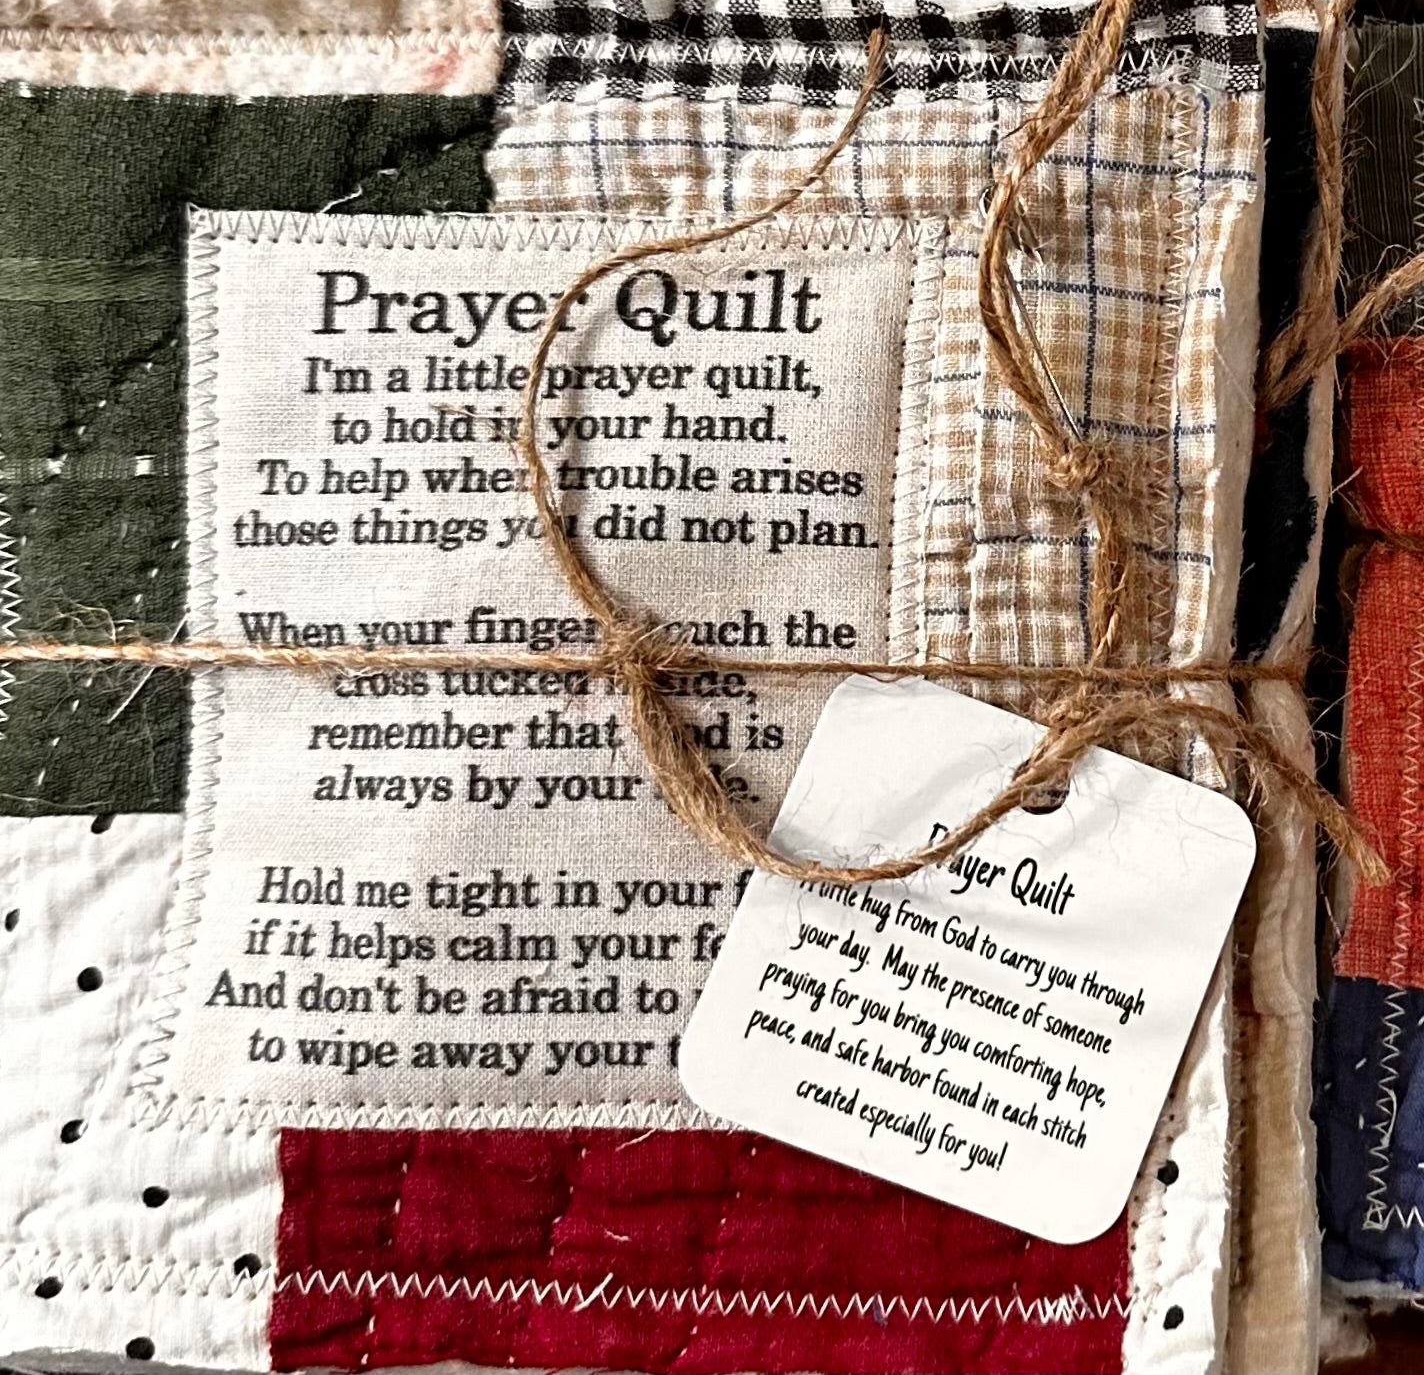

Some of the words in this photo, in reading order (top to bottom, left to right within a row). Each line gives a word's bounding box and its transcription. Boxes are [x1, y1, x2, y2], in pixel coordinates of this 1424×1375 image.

[311, 269, 592, 348] Prayer
[613, 268, 824, 348] Quilt
[301, 356, 373, 395] I'm
[385, 365, 411, 393] a
[422, 354, 531, 393] little
[541, 358, 696, 403] prayer
[703, 354, 824, 400] quilt,
[313, 764, 454, 810] always
[465, 763, 520, 811] by
[531, 768, 645, 810] your
[256, 866, 345, 906] Hold
[354, 881, 412, 910] me
[425, 867, 542, 919] tight
[550, 869, 602, 910] in
[612, 879, 724, 917] your
[1010, 857, 1076, 916] Quilt
[789, 923, 840, 951] your
[838, 929, 871, 974] day.
[881, 943, 920, 992] May
[920, 961, 949, 993] the
[945, 979, 1021, 1020] presence
[1021, 1001, 1047, 1029] of
[1043, 1015, 1113, 1055] someone
[249, 1029, 286, 1063] to
[297, 1028, 399, 1076] wipe
[410, 1041, 535, 1079] away
[544, 1040, 656, 1076] your
[743, 1009, 796, 1045] peace,
[800, 1026, 837, 1054] and
[834, 1037, 870, 1068] safe
[871, 1044, 932, 1089] harbor
[932, 1067, 983, 1109] found
[981, 1092, 1000, 1118] in
[1001, 1102, 1039, 1131] each
[1040, 1115, 1087, 1149] stitch
[795, 1080, 860, 1116] created
[859, 1103, 937, 1156] especially
[937, 1122, 968, 1155] for
[960, 1141, 1009, 1172] you!
